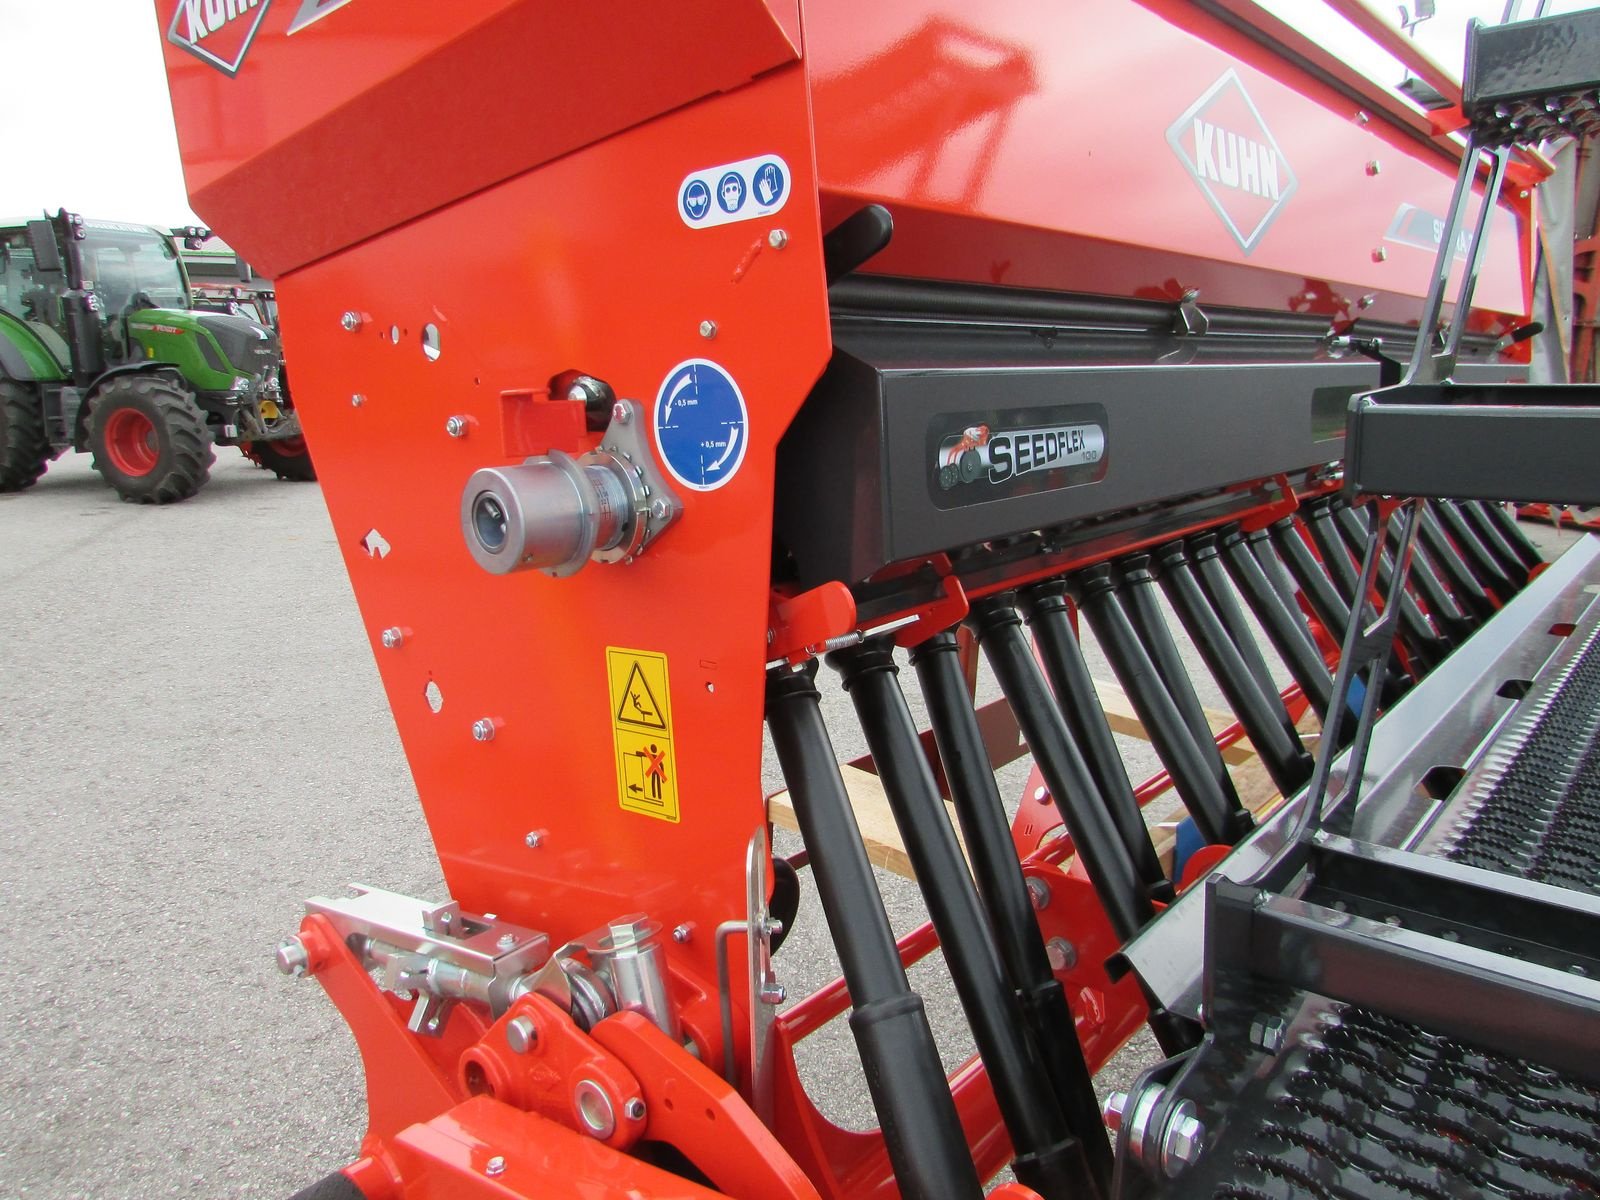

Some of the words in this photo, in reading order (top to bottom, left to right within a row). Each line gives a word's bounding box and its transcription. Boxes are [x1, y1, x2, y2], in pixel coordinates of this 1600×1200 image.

[185, 0, 258, 45] KU
[1194, 118, 1279, 201] KUHN
[988, 430, 1086, 484] SEEDFLEX
